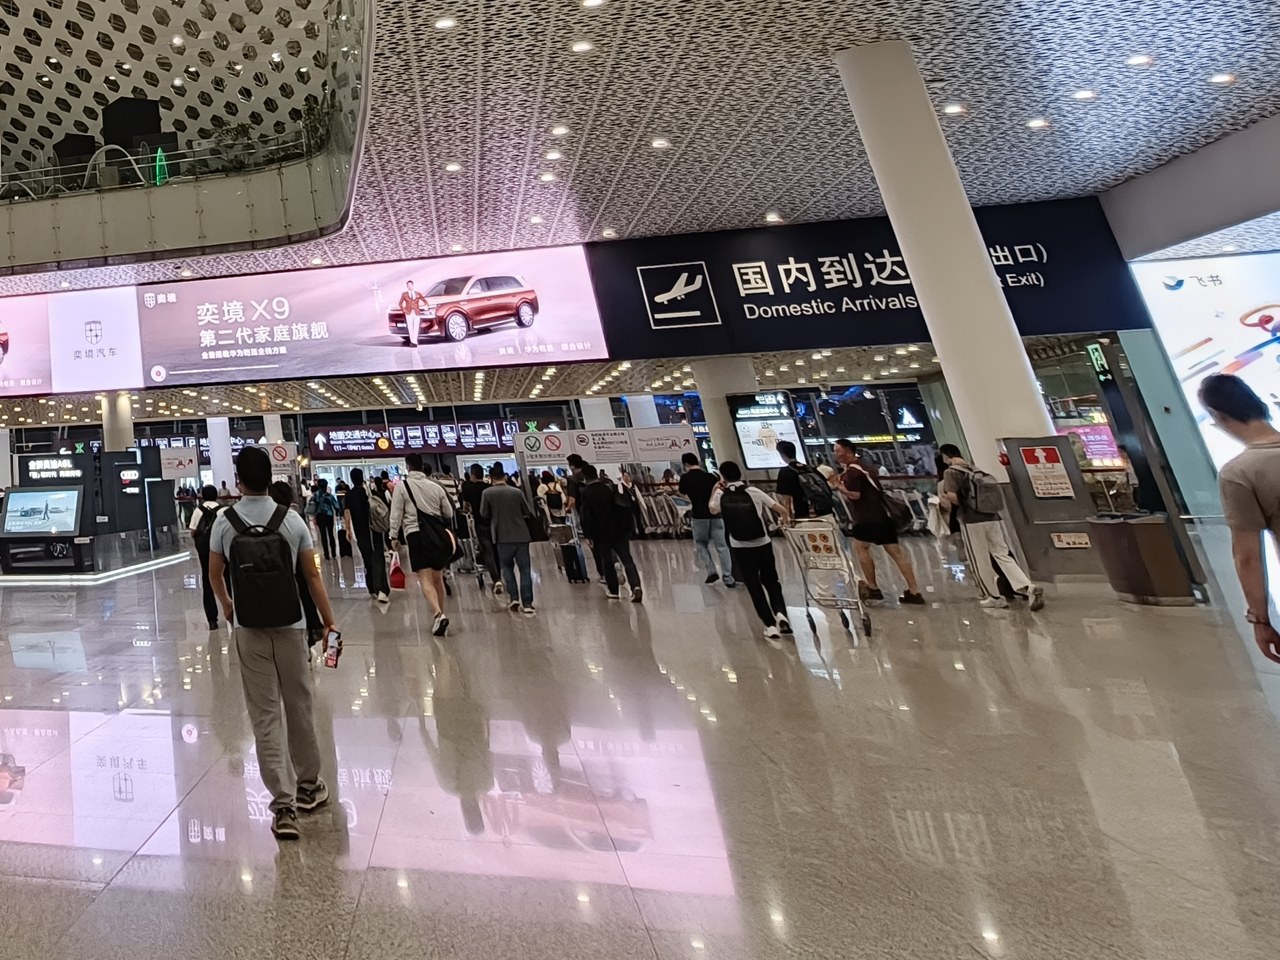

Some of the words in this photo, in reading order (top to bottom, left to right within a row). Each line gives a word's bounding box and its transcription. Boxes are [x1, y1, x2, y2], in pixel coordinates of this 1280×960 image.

[732, 249, 912, 297] 国内到达
[1188, 274, 1223, 287] 飞书
[196, 301, 246, 326] 奕境
[250, 296, 290, 321] X9
[743, 298, 836, 320] Domestic
[841, 293, 918, 314] Arrivals
[199, 321, 329, 348] 第二代家庭旗舰
[73, 346, 118, 360] 奕境汽车
